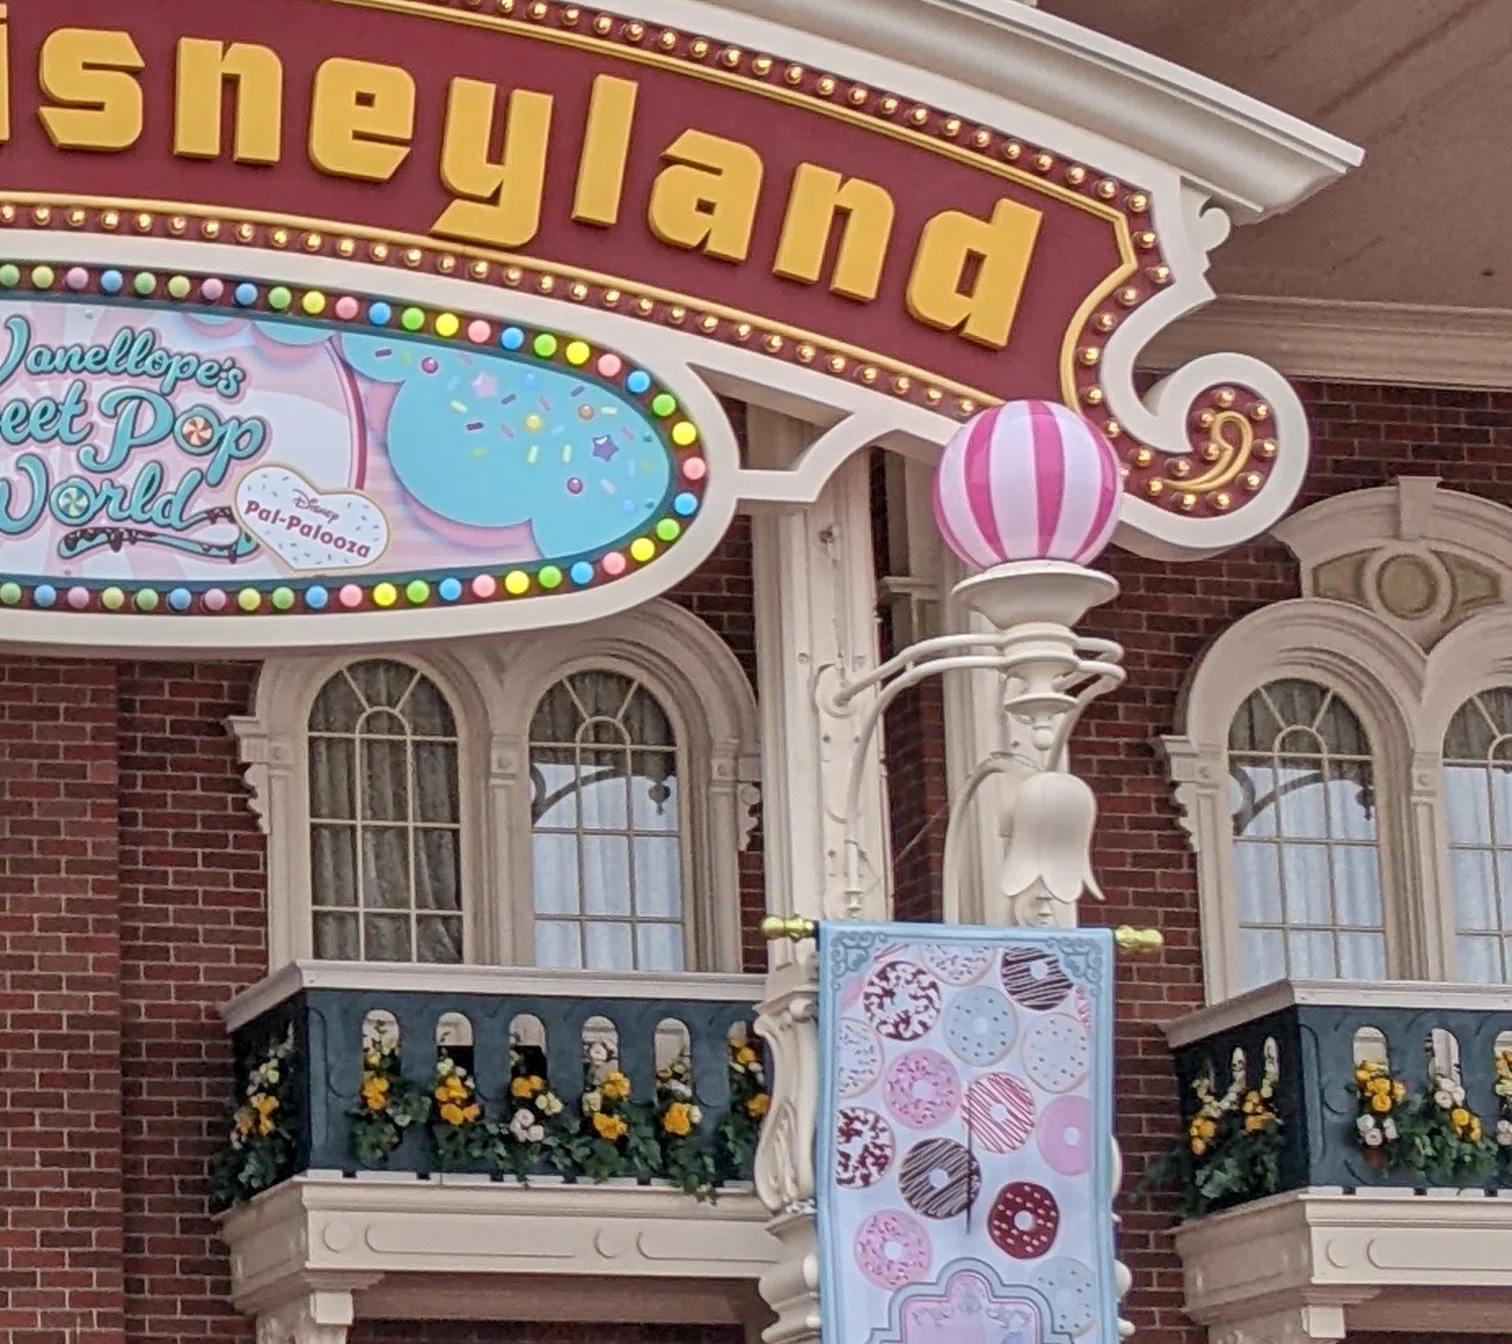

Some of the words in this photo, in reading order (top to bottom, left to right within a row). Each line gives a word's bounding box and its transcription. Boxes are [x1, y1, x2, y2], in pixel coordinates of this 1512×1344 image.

[79, 387, 267, 486] Pop
[244, 500, 372, 558] Pal-Palooza
[292, 488, 340, 524] Disney
